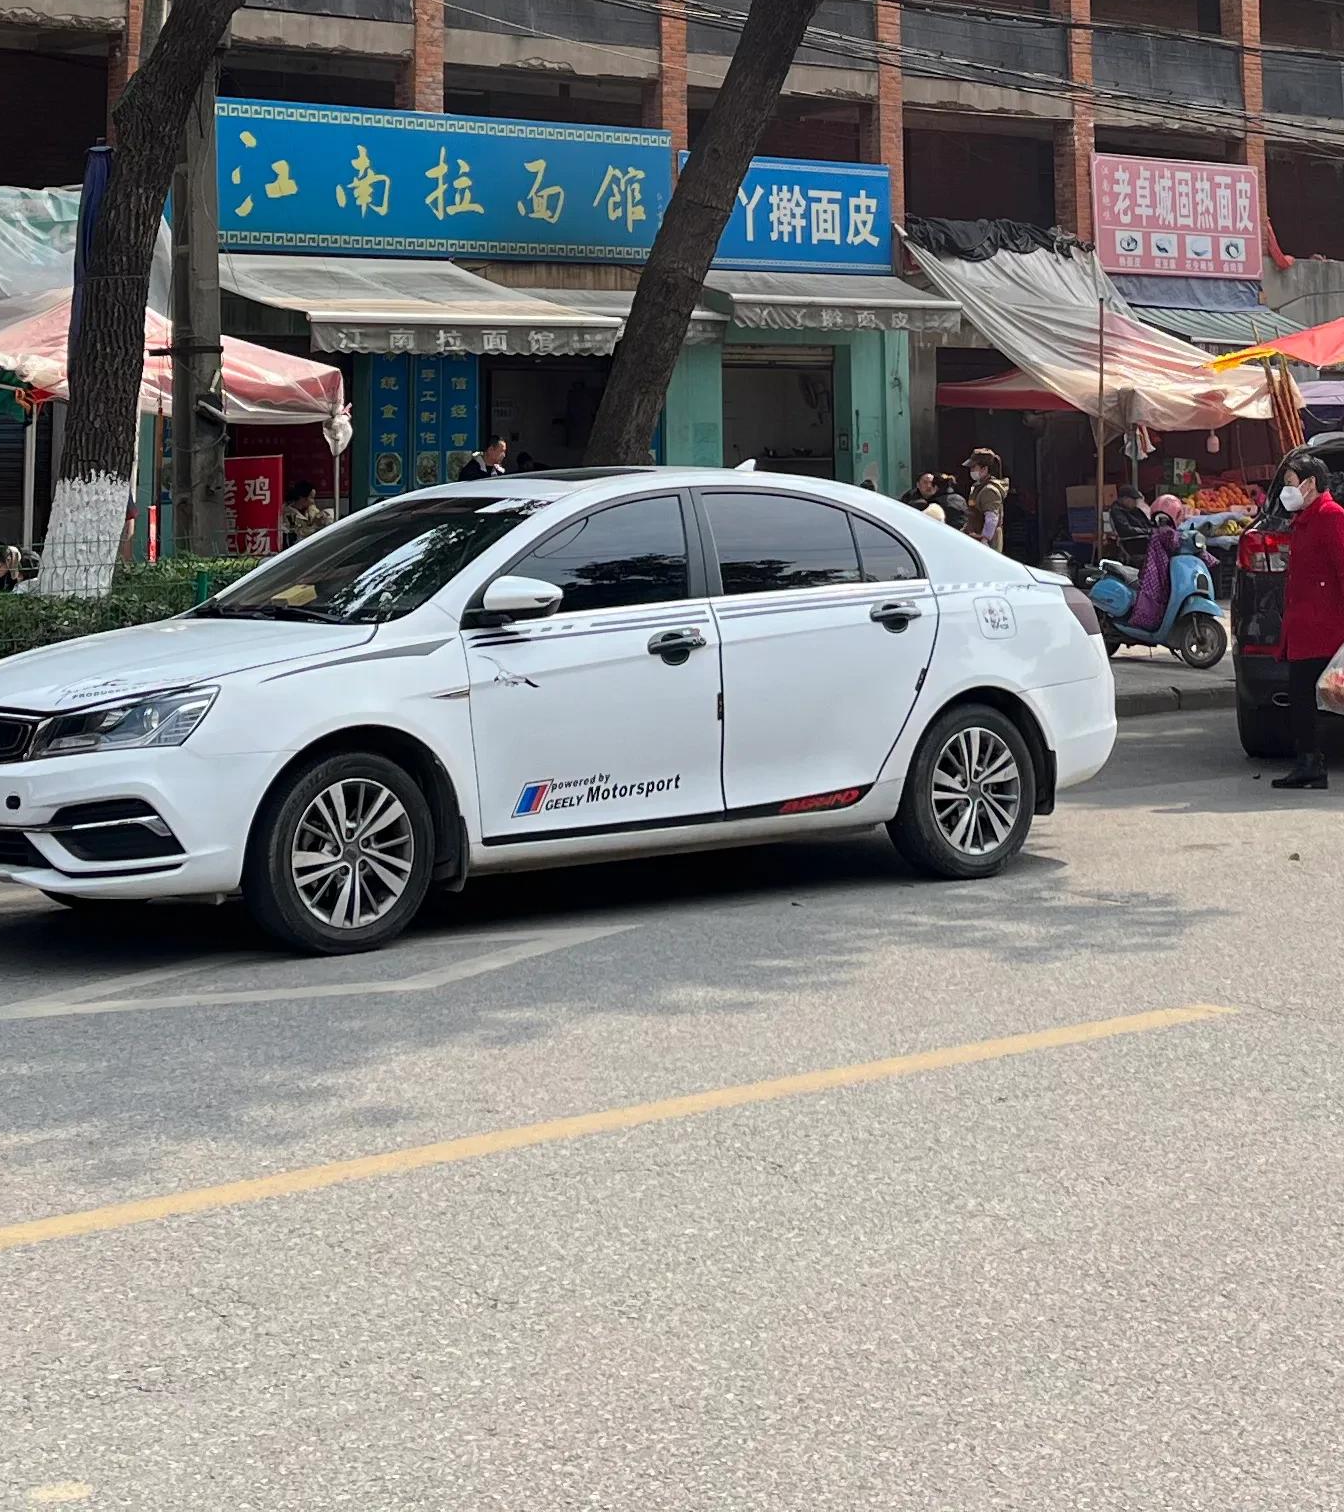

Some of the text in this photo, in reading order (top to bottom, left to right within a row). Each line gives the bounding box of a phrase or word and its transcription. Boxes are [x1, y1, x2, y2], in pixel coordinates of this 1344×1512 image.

[231, 131, 647, 232] 江南拉面馆
[338, 329, 555, 351] 江南拉面馆
[545, 774, 681, 811] GEELY Motorsport
[551, 773, 611, 793] powered by
